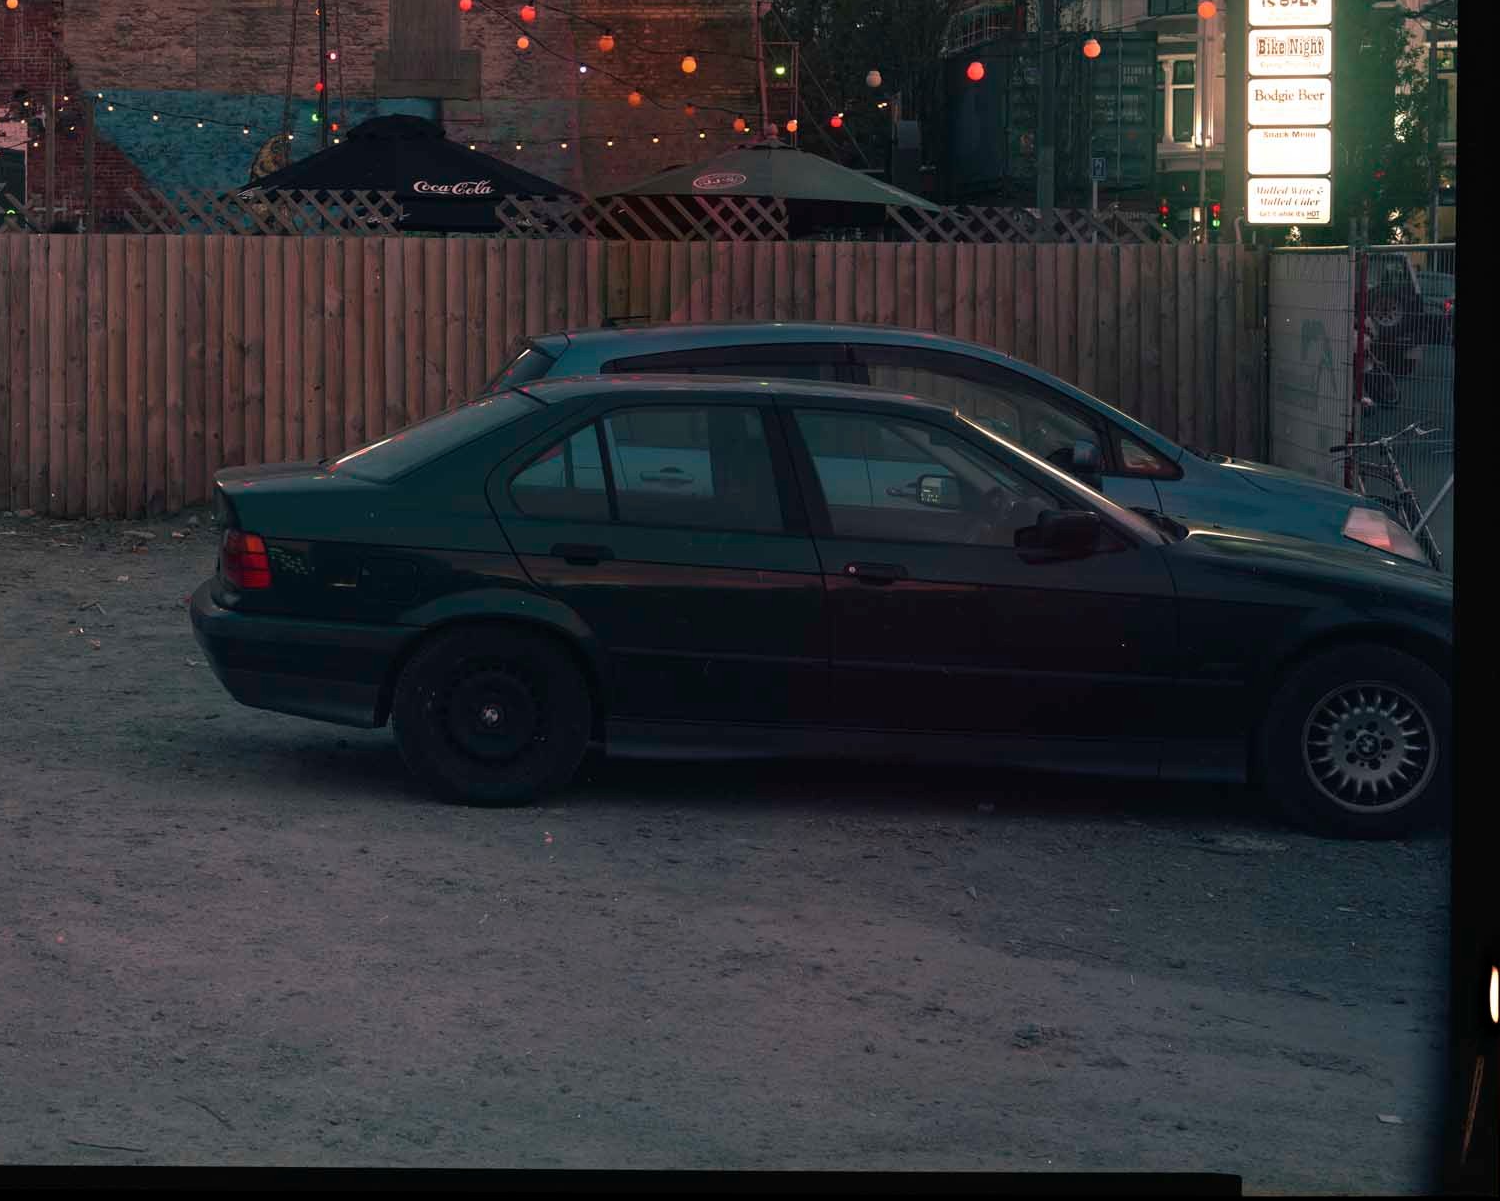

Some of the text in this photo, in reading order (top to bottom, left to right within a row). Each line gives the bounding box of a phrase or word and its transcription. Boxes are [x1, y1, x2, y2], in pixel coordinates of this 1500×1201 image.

[1257, 36, 1325, 58] Bike Night
[1254, 88, 1325, 103] Bodgie Beer
[1263, 130, 1316, 139] Snack Menu
[413, 179, 496, 195] Coca-Cola
[1256, 186, 1288, 195] Mulled
[1260, 197, 1321, 206] Mulled Cider
[1307, 210, 1320, 218] HOT
